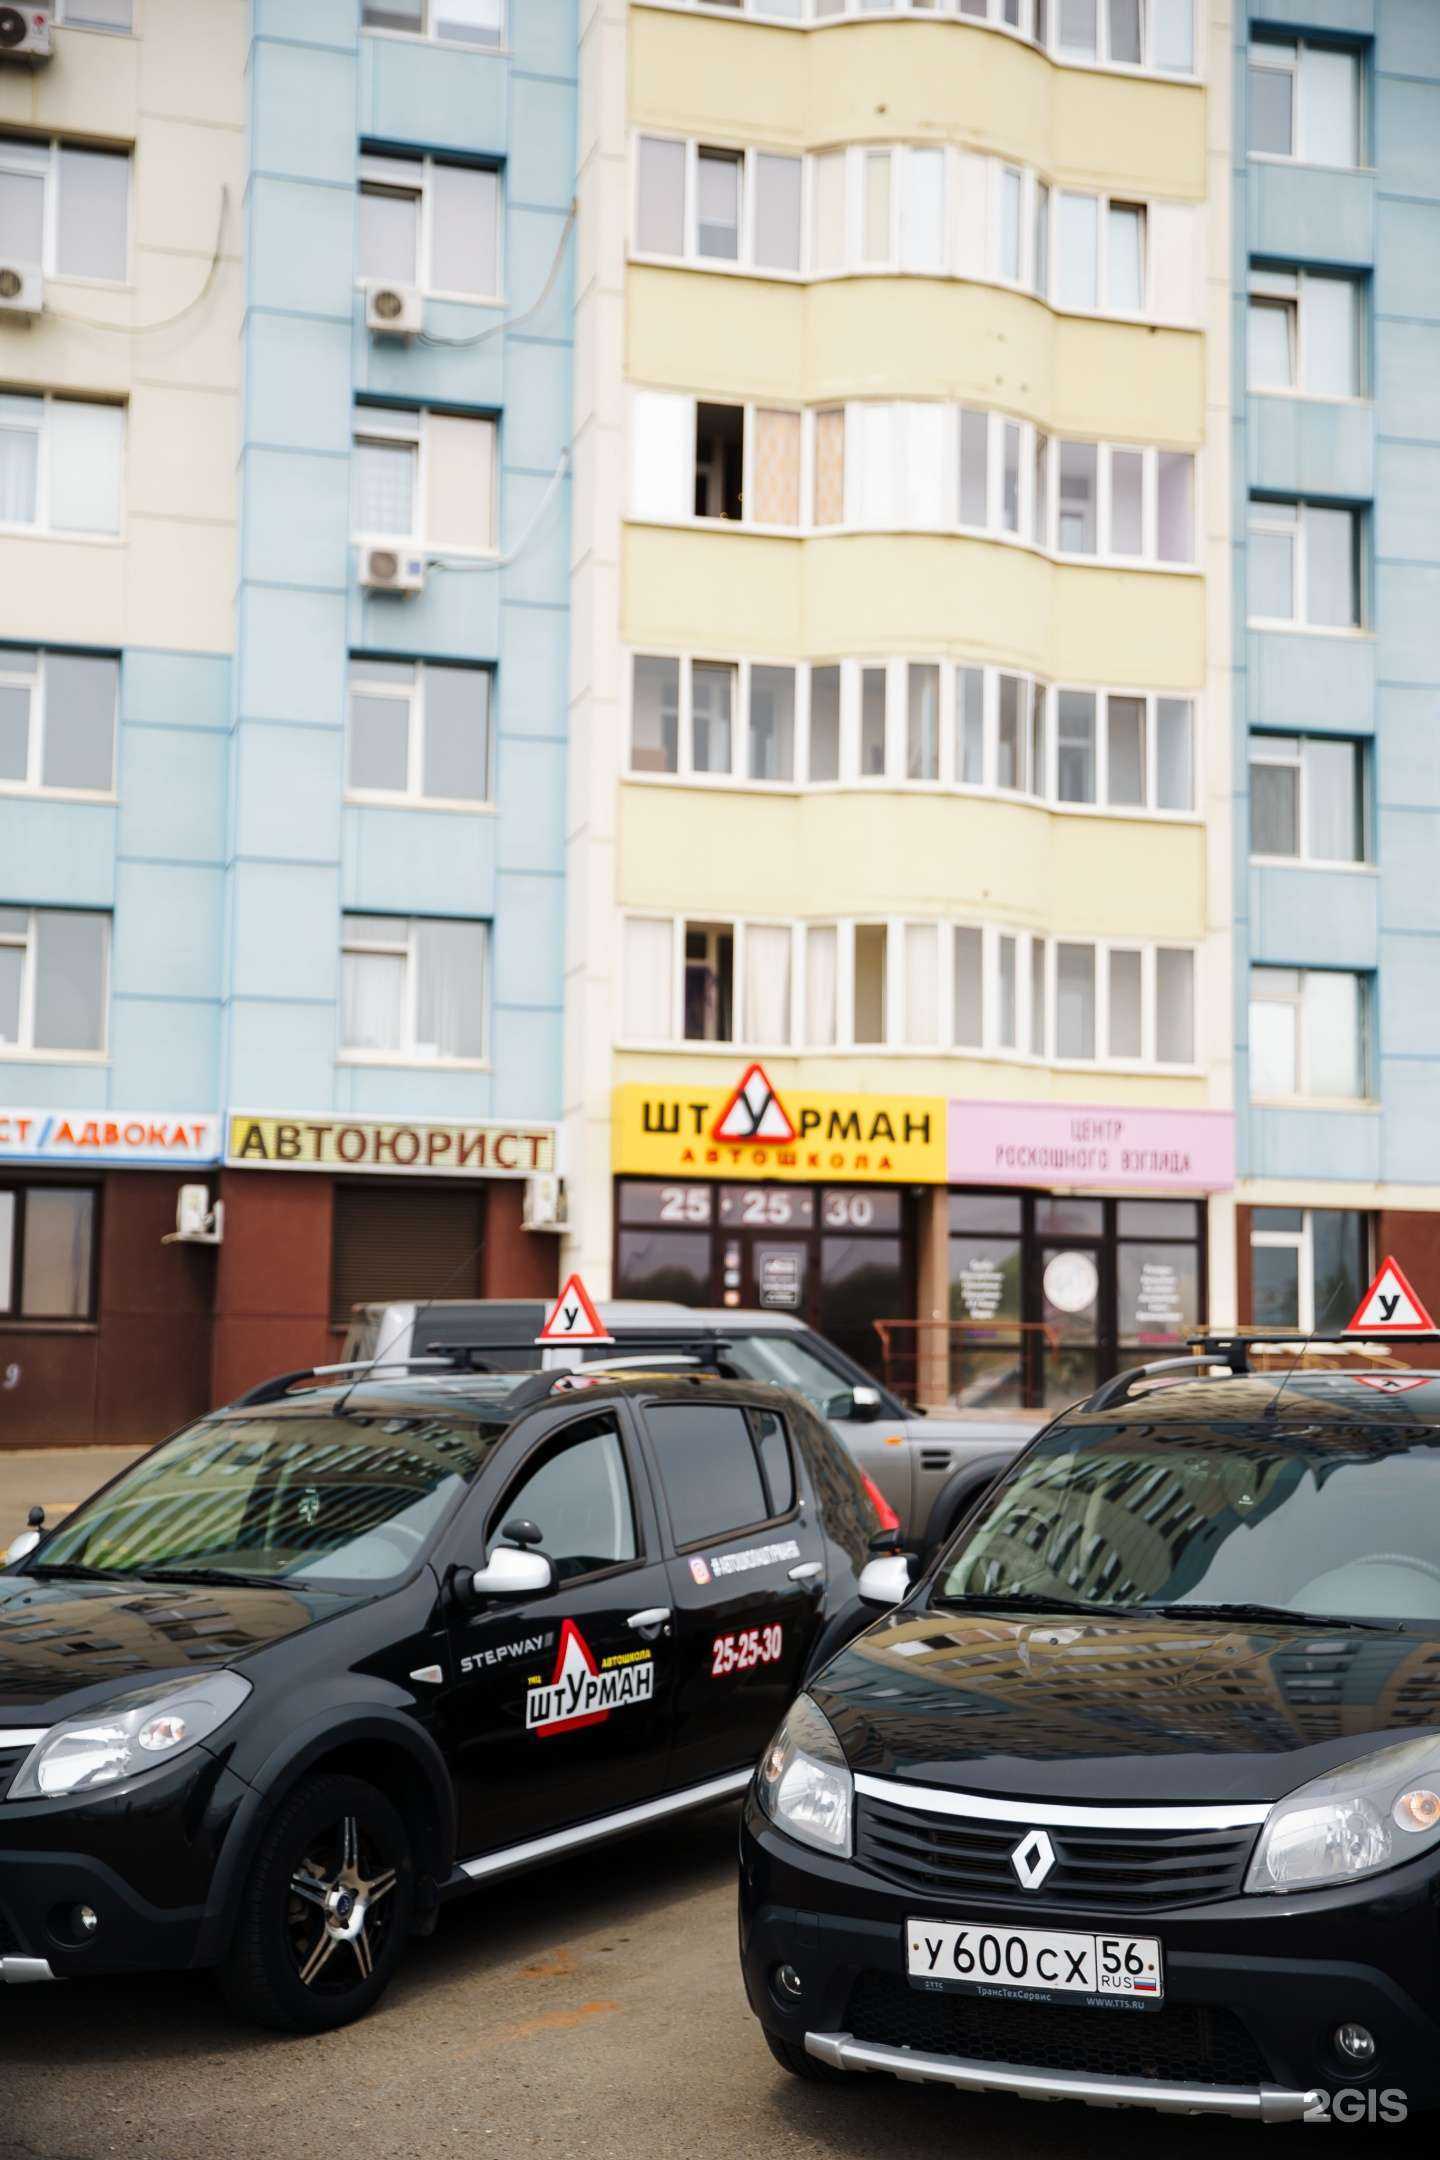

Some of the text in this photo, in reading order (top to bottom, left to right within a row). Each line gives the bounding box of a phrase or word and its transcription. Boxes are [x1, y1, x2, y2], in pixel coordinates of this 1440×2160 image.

[641, 1090, 931, 1144] ШТУРМАН
[1070, 1118, 1126, 1142] ЦЕНТР
[239, 1124, 548, 1169] АВТОЮРИСТ
[681, 1148, 893, 1170] АВТОШКОЛА
[995, 1147, 1192, 1174] РОСКОШНОГО ВЗГЛЯДА
[564, 1307, 579, 1330] У
[1378, 1295, 1400, 1321] У
[460, 1635, 544, 1673] STEPWAY
[602, 1649, 652, 1669] АВТОШКОЛА
[712, 1625, 783, 1675] 25-25-30
[530, 1669, 652, 1723] ШТУРМАН
[1102, 1941, 1144, 1975] 56
[976, 1986, 1052, 2002] ТрансТехСервис
[1102, 1975, 1132, 1989] RUS
[1086, 1997, 1145, 2010] WWW.TTS.RU
